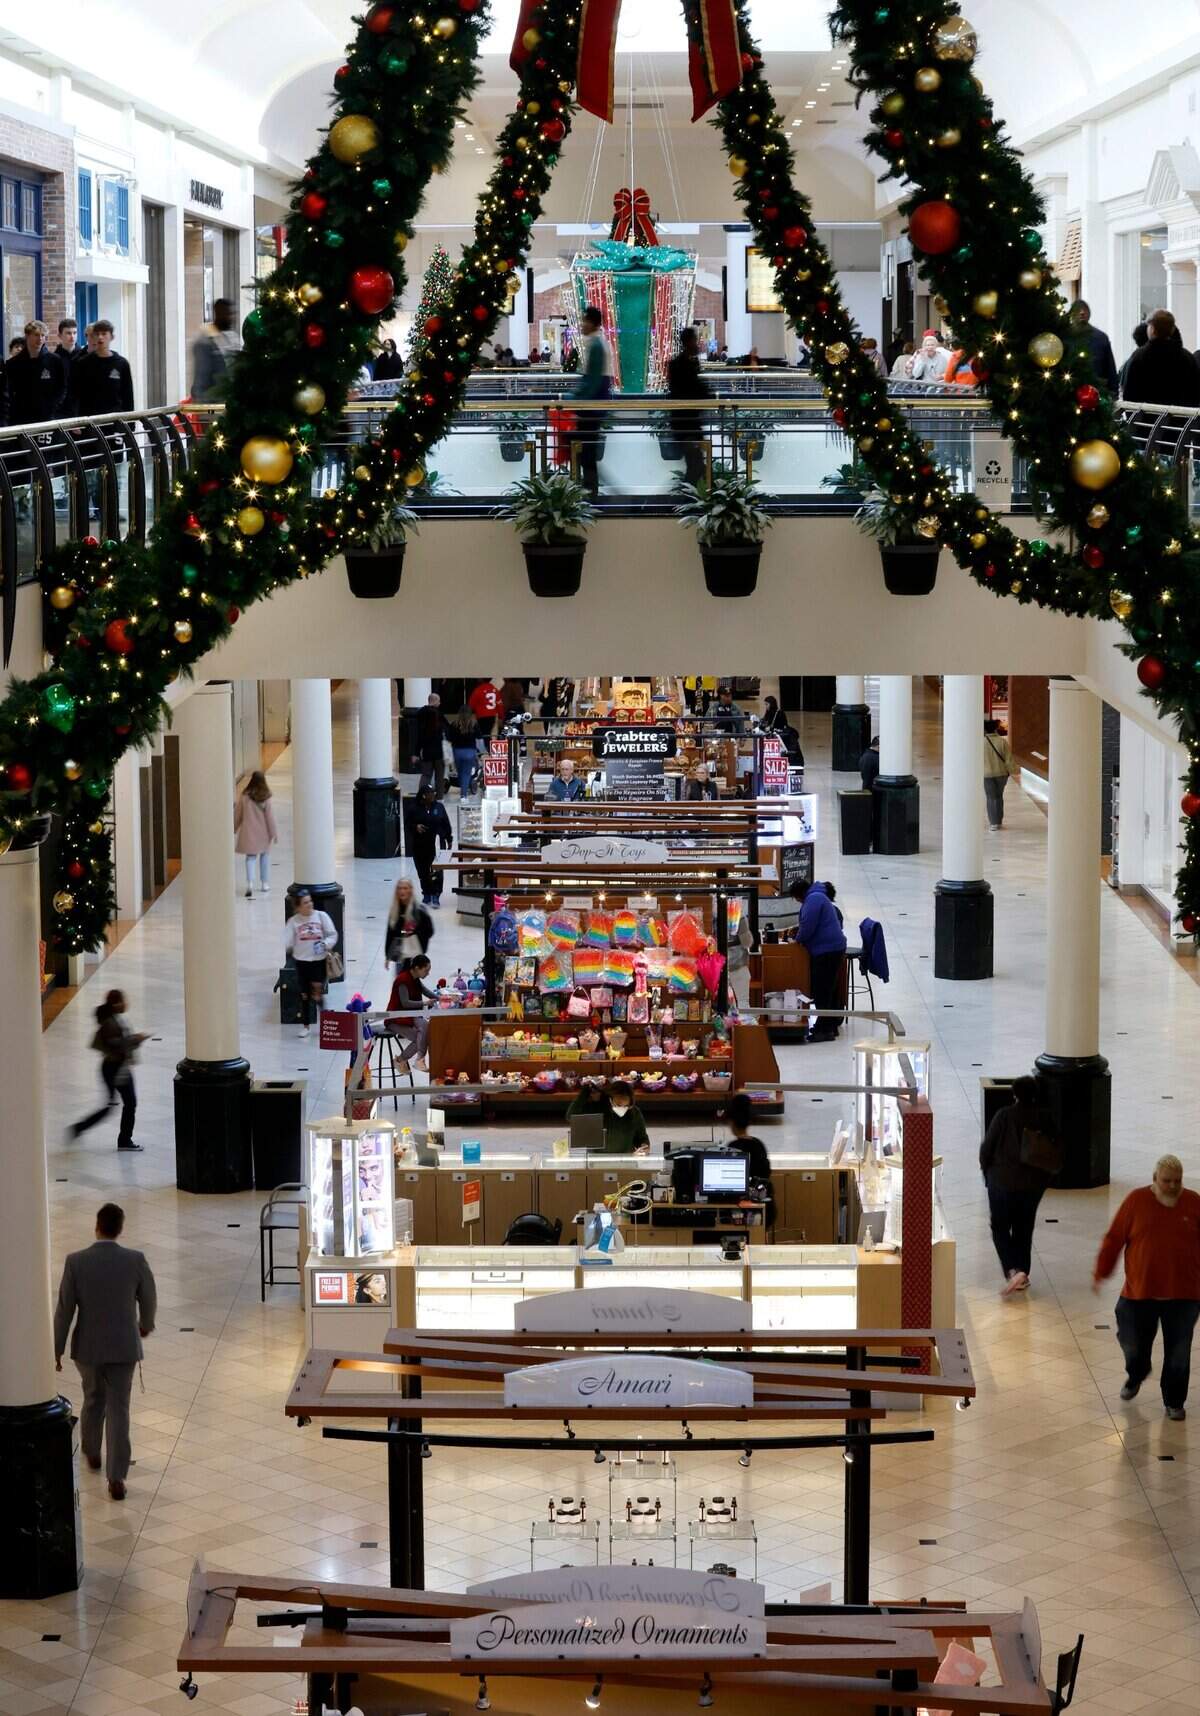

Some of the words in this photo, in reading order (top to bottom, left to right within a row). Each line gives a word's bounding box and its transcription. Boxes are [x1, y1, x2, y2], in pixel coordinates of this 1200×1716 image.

[485, 692, 497, 710] 3
[605, 731, 670, 742] Crabtre
[485, 760, 507, 776] SALE
[765, 759, 787, 775] SALE
[619, 843, 647, 860] Toys
[577, 1367, 673, 1396] Amari
[476, 1615, 625, 1651] Personalized
[631, 1615, 749, 1646] Ornaments
